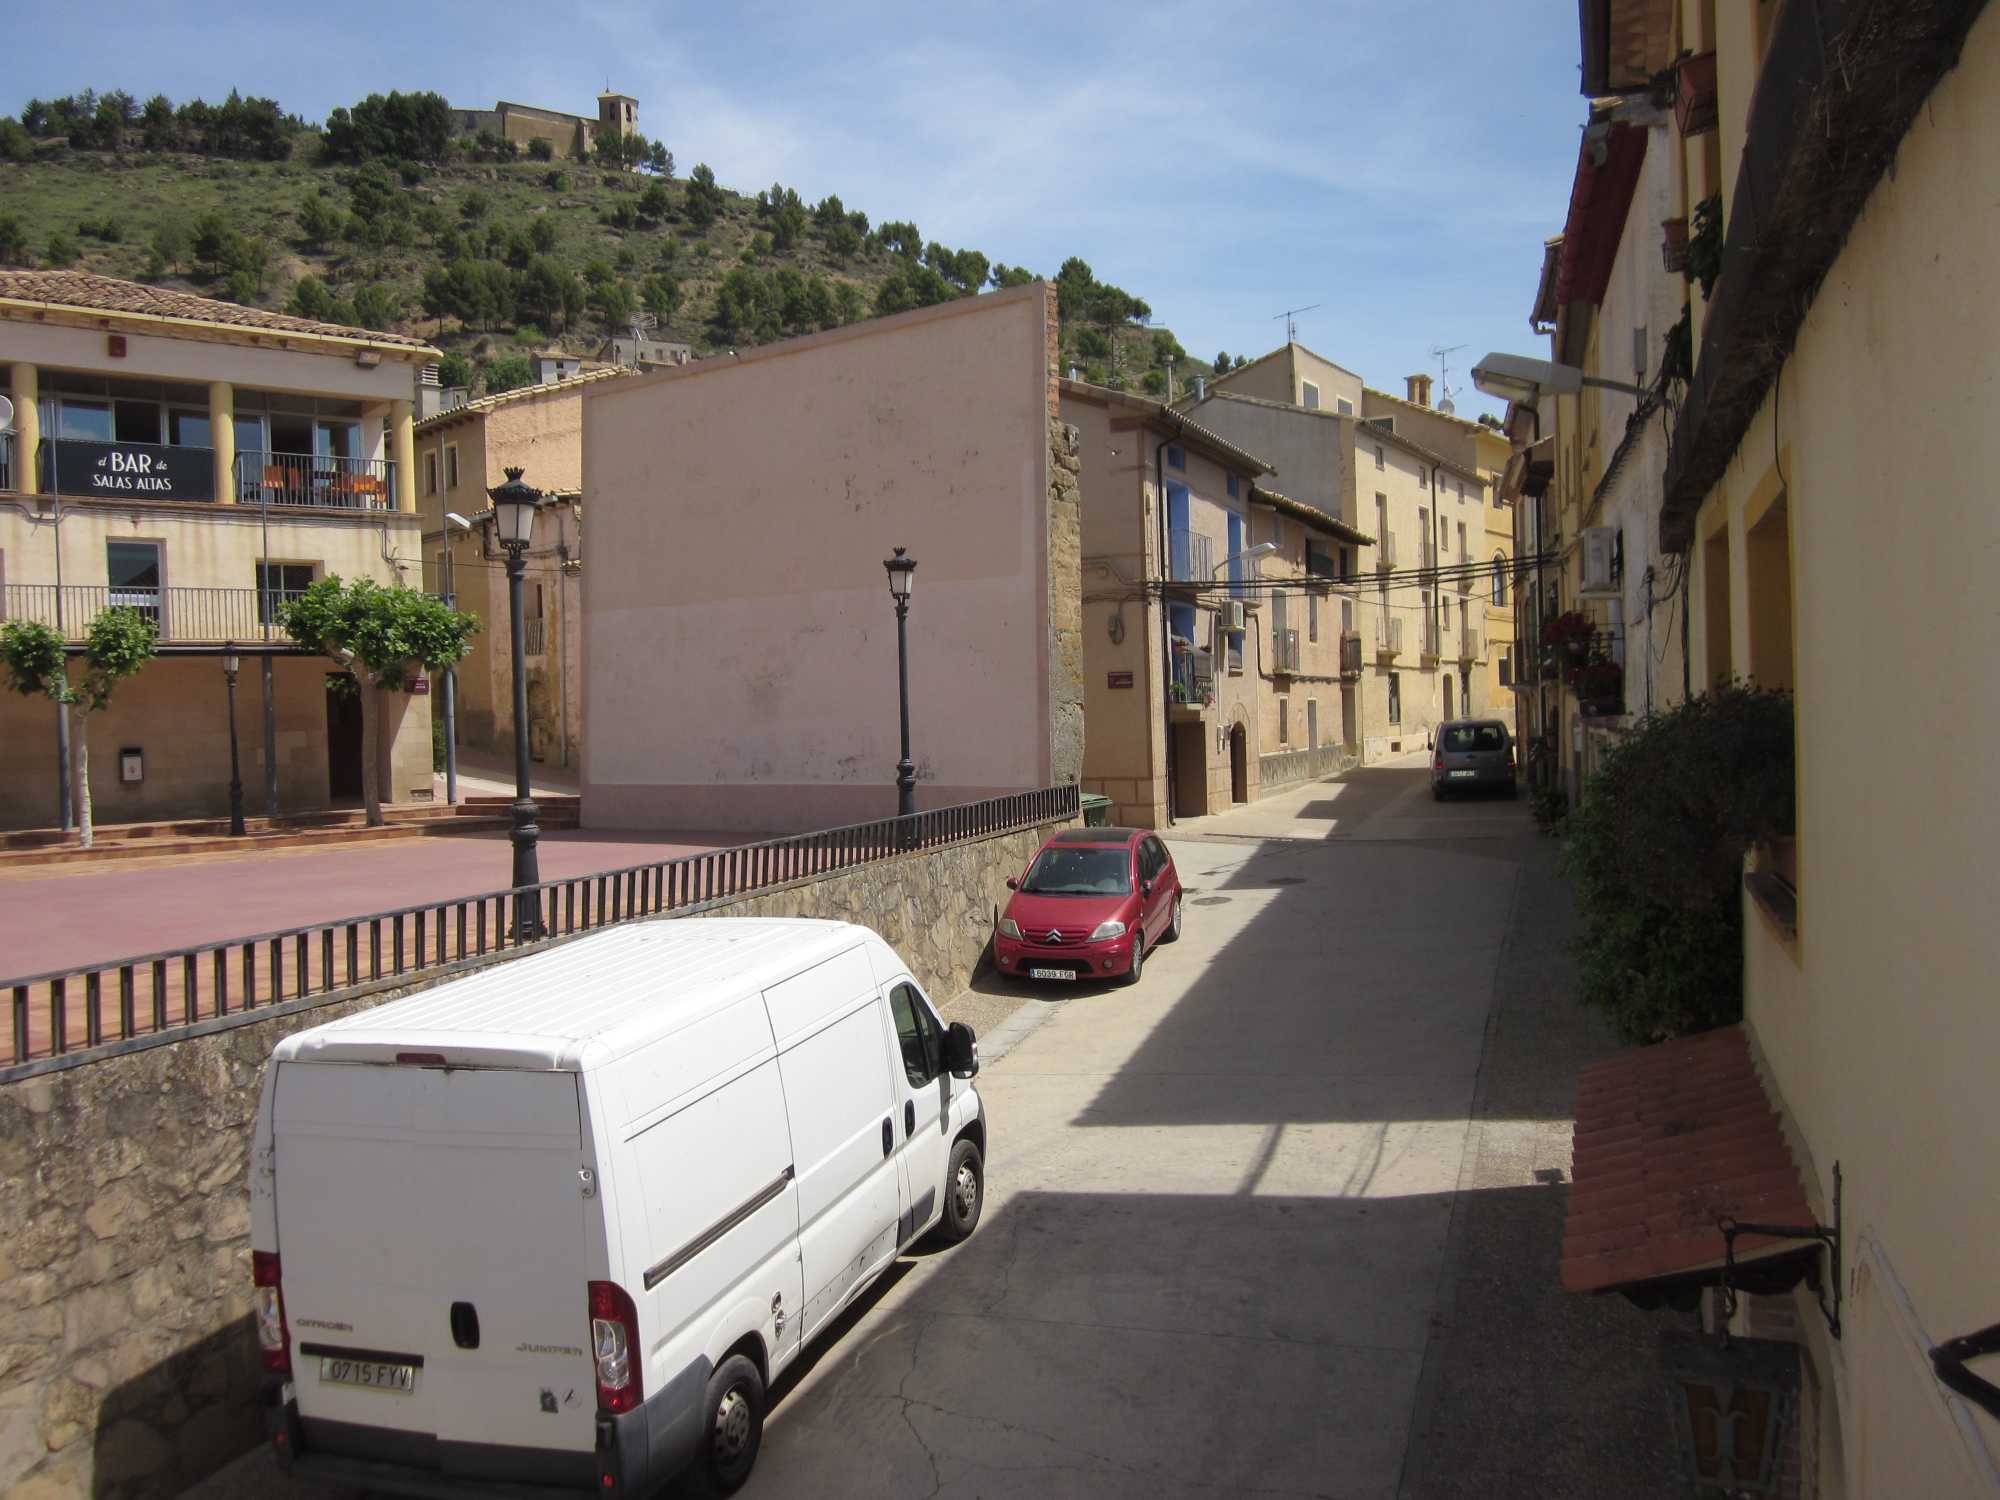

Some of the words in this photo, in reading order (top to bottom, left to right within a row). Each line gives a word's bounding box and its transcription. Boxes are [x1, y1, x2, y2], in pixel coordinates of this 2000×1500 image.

[98, 456, 108, 467] el
[111, 452, 152, 473] BAR
[155, 461, 168, 470] de
[92, 473, 132, 489] SALAS
[136, 478, 172, 490] ALTAS
[514, 1342, 583, 1357] JUMPER
[332, 1360, 372, 1383] 0715
[376, 1365, 409, 1386] FYV
